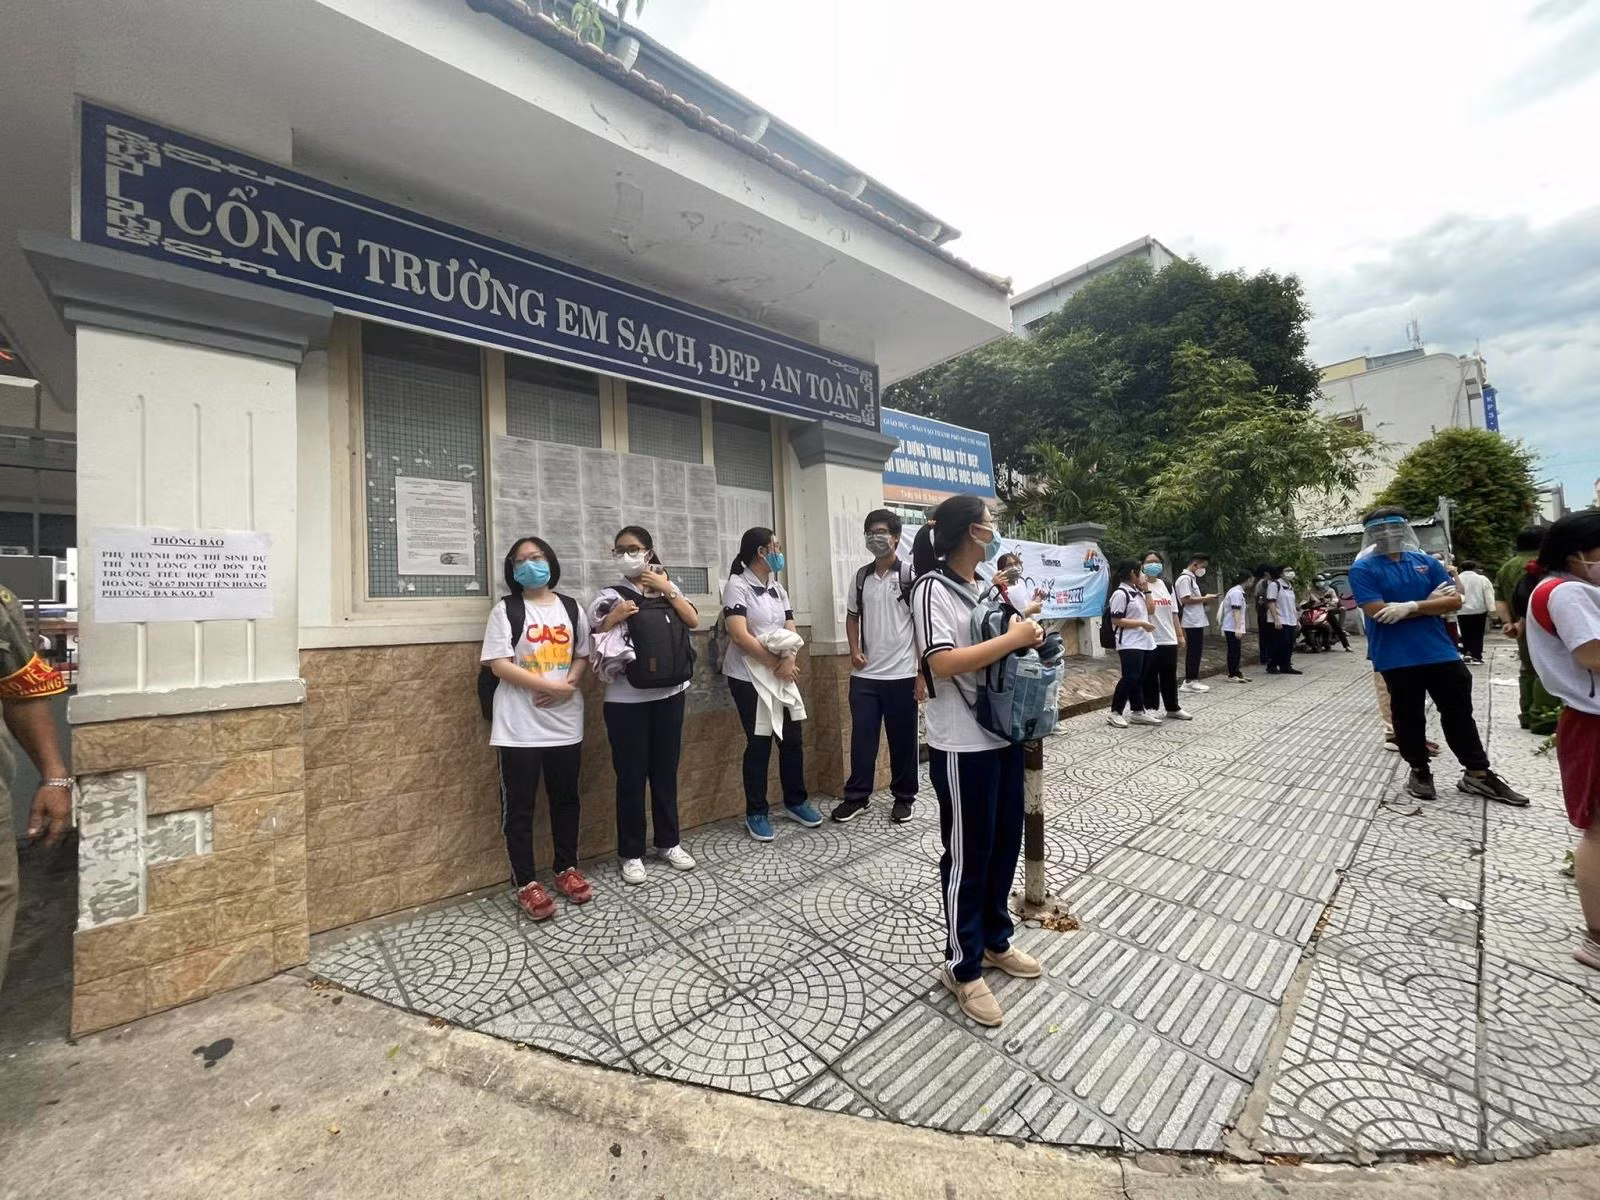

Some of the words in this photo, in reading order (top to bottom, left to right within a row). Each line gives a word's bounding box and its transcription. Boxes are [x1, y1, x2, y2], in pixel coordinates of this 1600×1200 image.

[169, 185, 345, 274] CỔNG
[358, 239, 547, 329] TRƯỜNG
[556, 297, 609, 346] EM
[617, 316, 703, 376] SẠCH,
[771, 364, 801, 396] AN
[806, 372, 859, 410] TOÀN
[895, 457, 919, 476] KHÔNG
[151, 535, 196, 546] THÔNG
[199, 537, 225, 547] BÁO
[101, 550, 125, 560] PHỤ
[130, 551, 171, 560] HUYNH
[225, 554, 248, 562] SINH
[101, 569, 151, 578] TRƯỜNG
[186, 571, 209, 580] HỌC
[165, 580, 176, 588] 67
[101, 588, 151, 598] PHƯỜNG
[1151, 598, 1172, 606] mile
[526, 623, 570, 645] CA3
